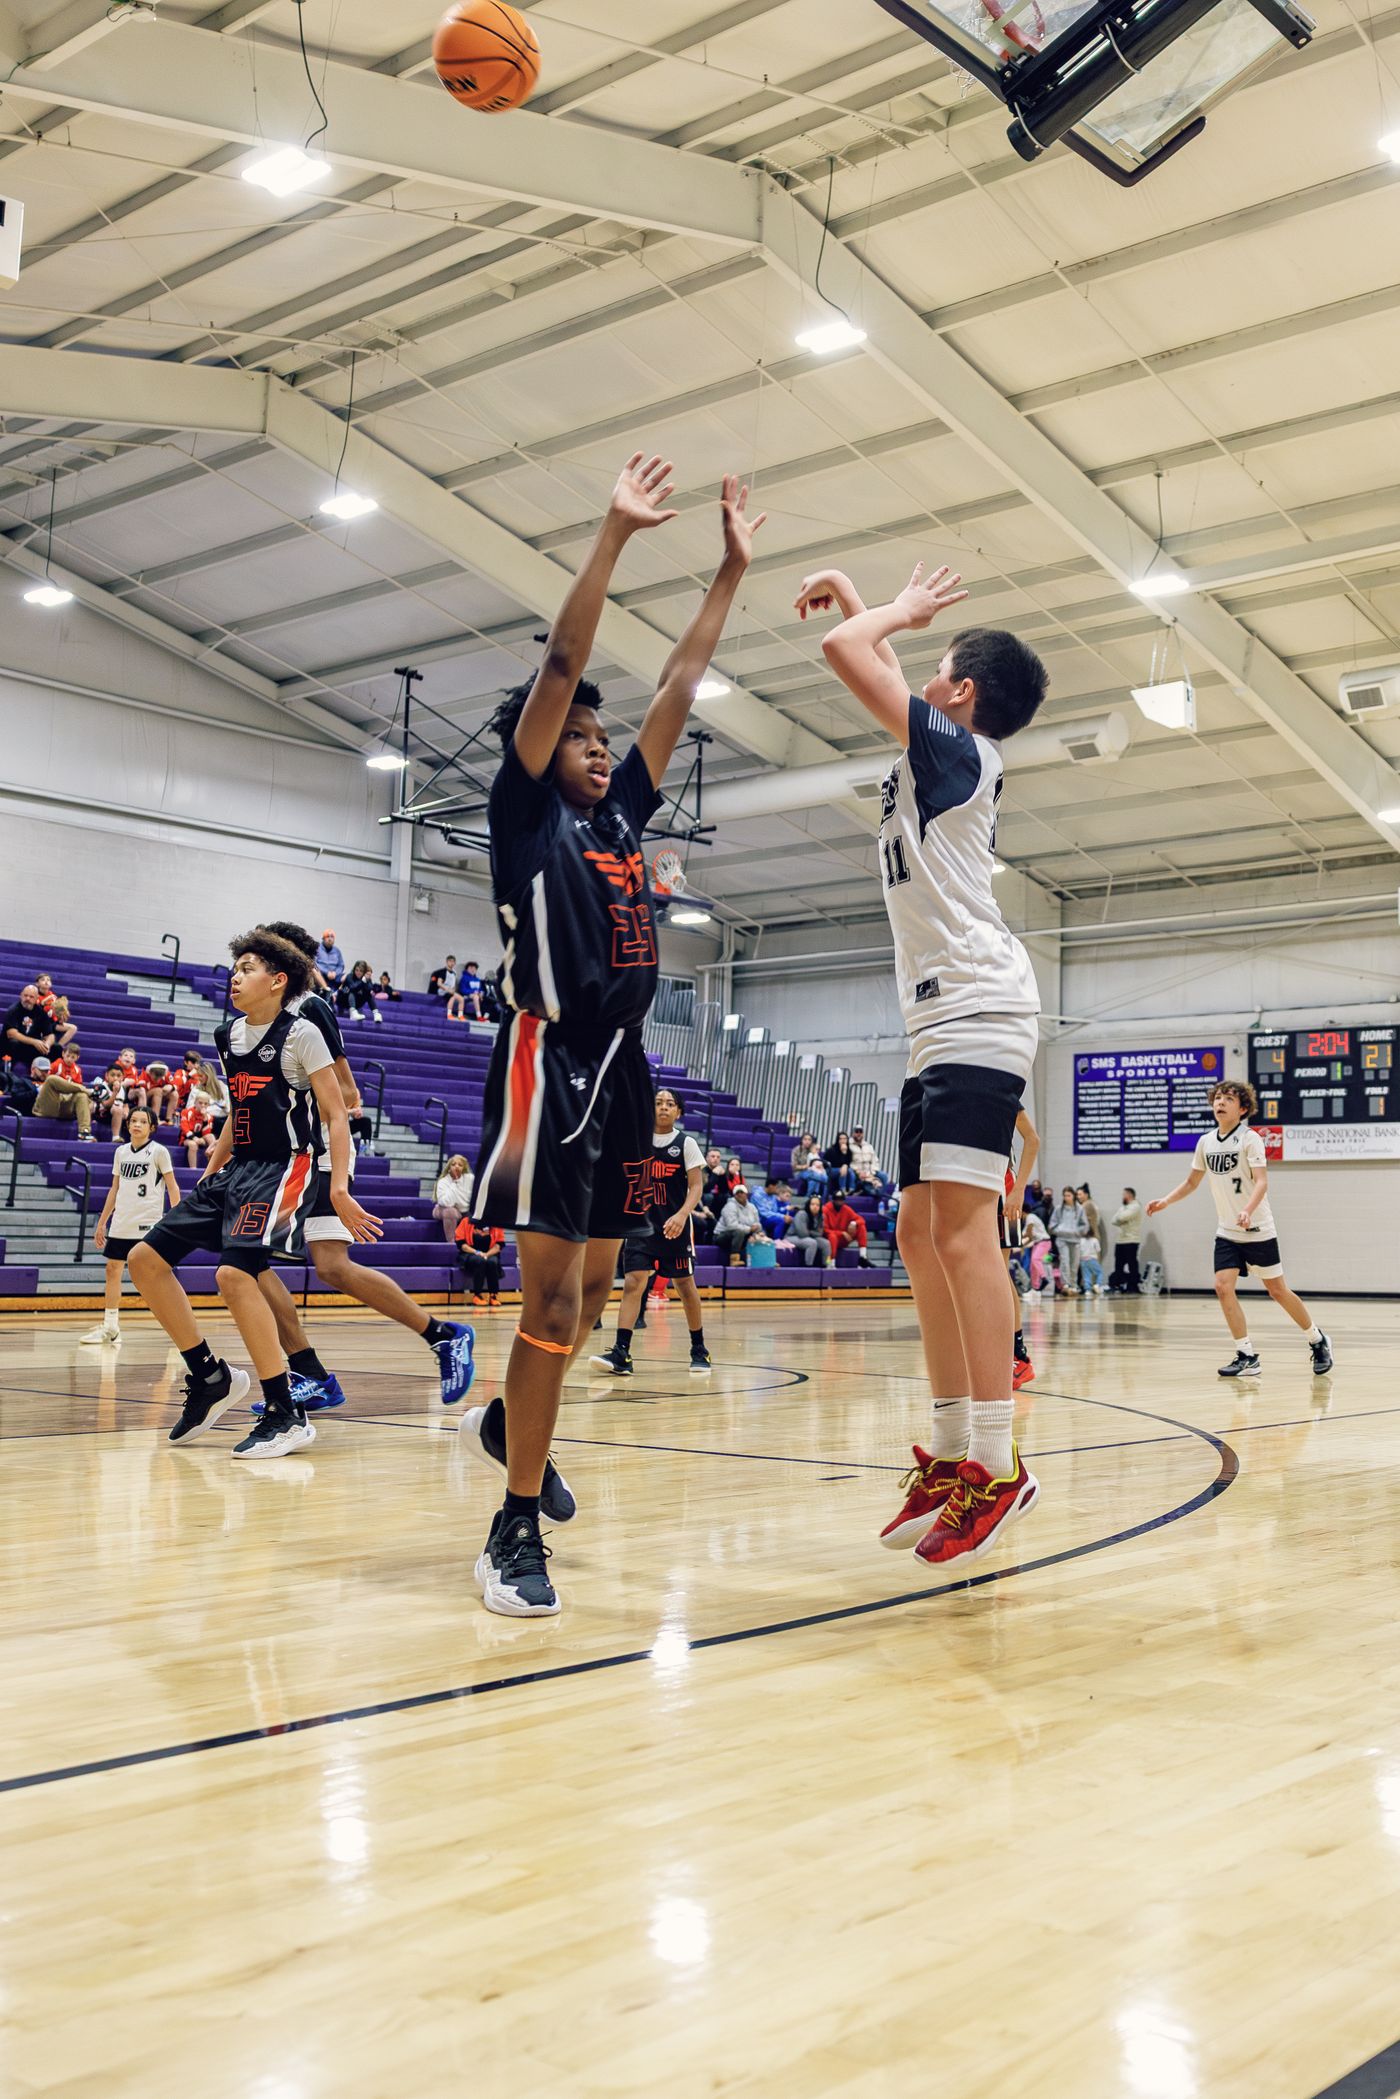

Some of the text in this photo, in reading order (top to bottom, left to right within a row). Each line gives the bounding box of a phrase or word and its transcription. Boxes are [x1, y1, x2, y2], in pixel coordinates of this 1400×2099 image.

[884, 835, 911, 888] 11
[1253, 1035, 1288, 1047] GUEST
[1308, 1031, 1349, 1056] 2:04
[1360, 1030, 1393, 1041] HOME
[1091, 1053, 1197, 1069] SMS BASKETBALL
[1272, 1050, 1284, 1072] 4
[1365, 1044, 1392, 1068] 21
[1107, 1067, 1187, 1078] SPONSORS
[1294, 1067, 1327, 1077] PERIOD
[1365, 1087, 1389, 1095] FOULS
[233, 1108, 251, 1144] 5
[1286, 1126, 1400, 1139] CITIZENS NATIONAL BANK
[120, 1162, 150, 1178] KINGS
[1206, 1152, 1239, 1172] KINGS
[137, 1184, 147, 1197] 3
[1232, 1177, 1242, 1194] 7
[231, 1202, 270, 1236] 15
